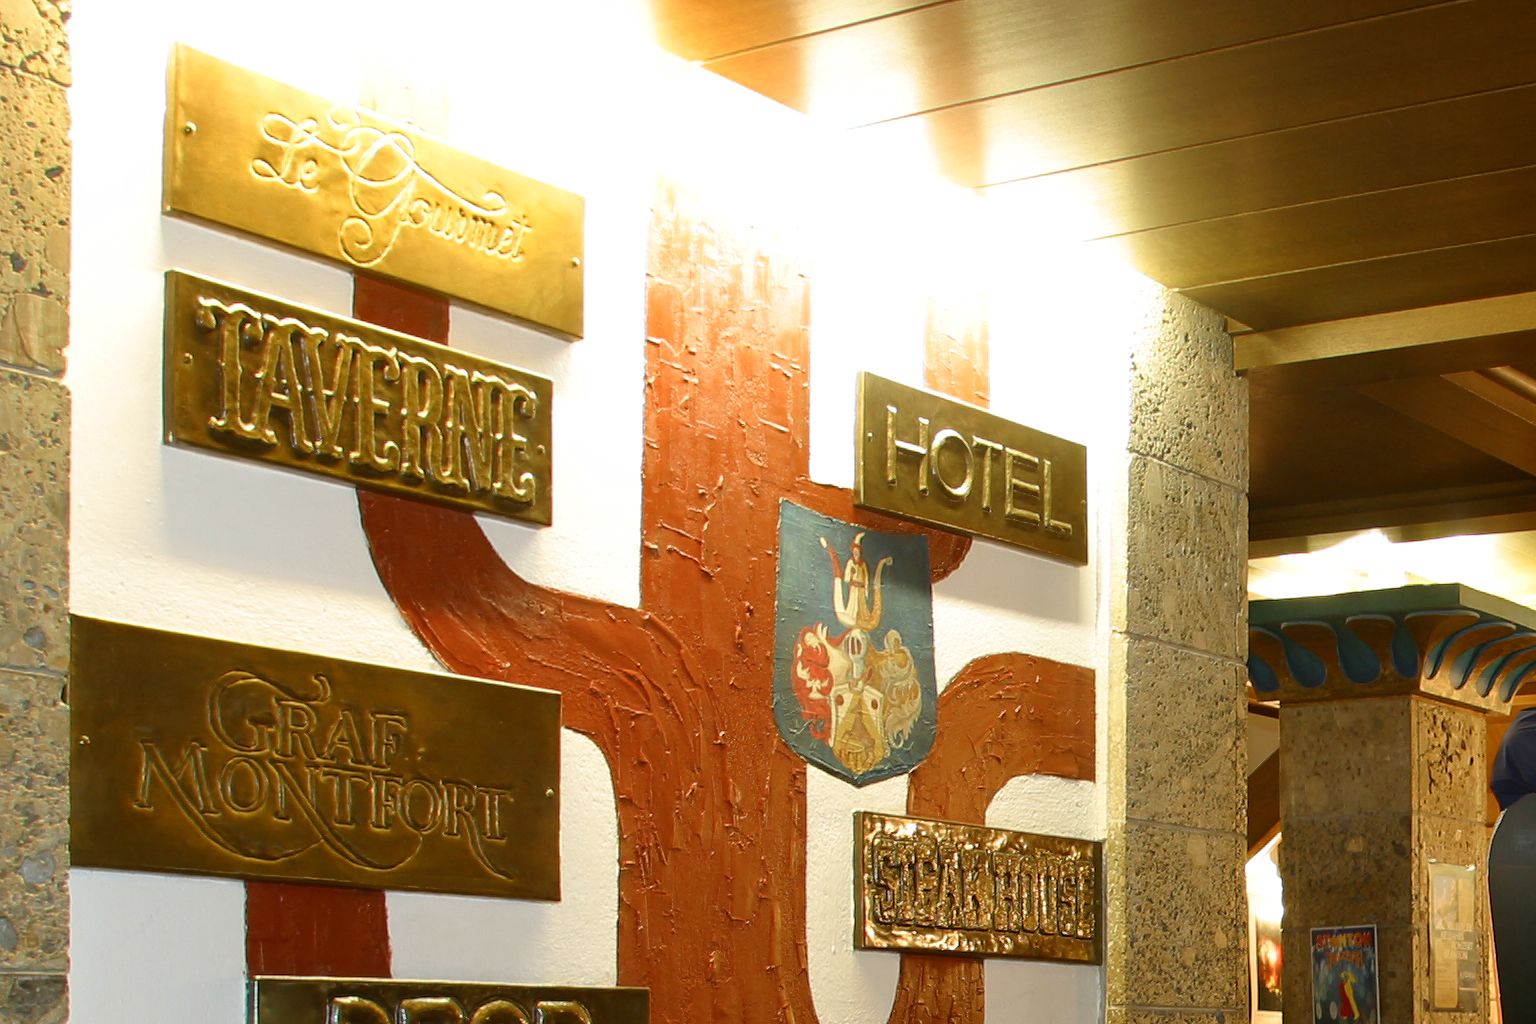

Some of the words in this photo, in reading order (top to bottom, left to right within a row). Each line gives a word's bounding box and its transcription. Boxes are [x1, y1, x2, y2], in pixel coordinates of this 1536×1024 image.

[251, 112, 325, 193] Le
[335, 112, 533, 267] Gourmet
[197, 296, 537, 507] TAVERNE
[886, 404, 1074, 537] HOTEL
[208, 670, 409, 769] GRAF
[133, 738, 514, 881] MONTFORT
[871, 833, 993, 931] STEAK
[993, 850, 1095, 940] HOUSE
